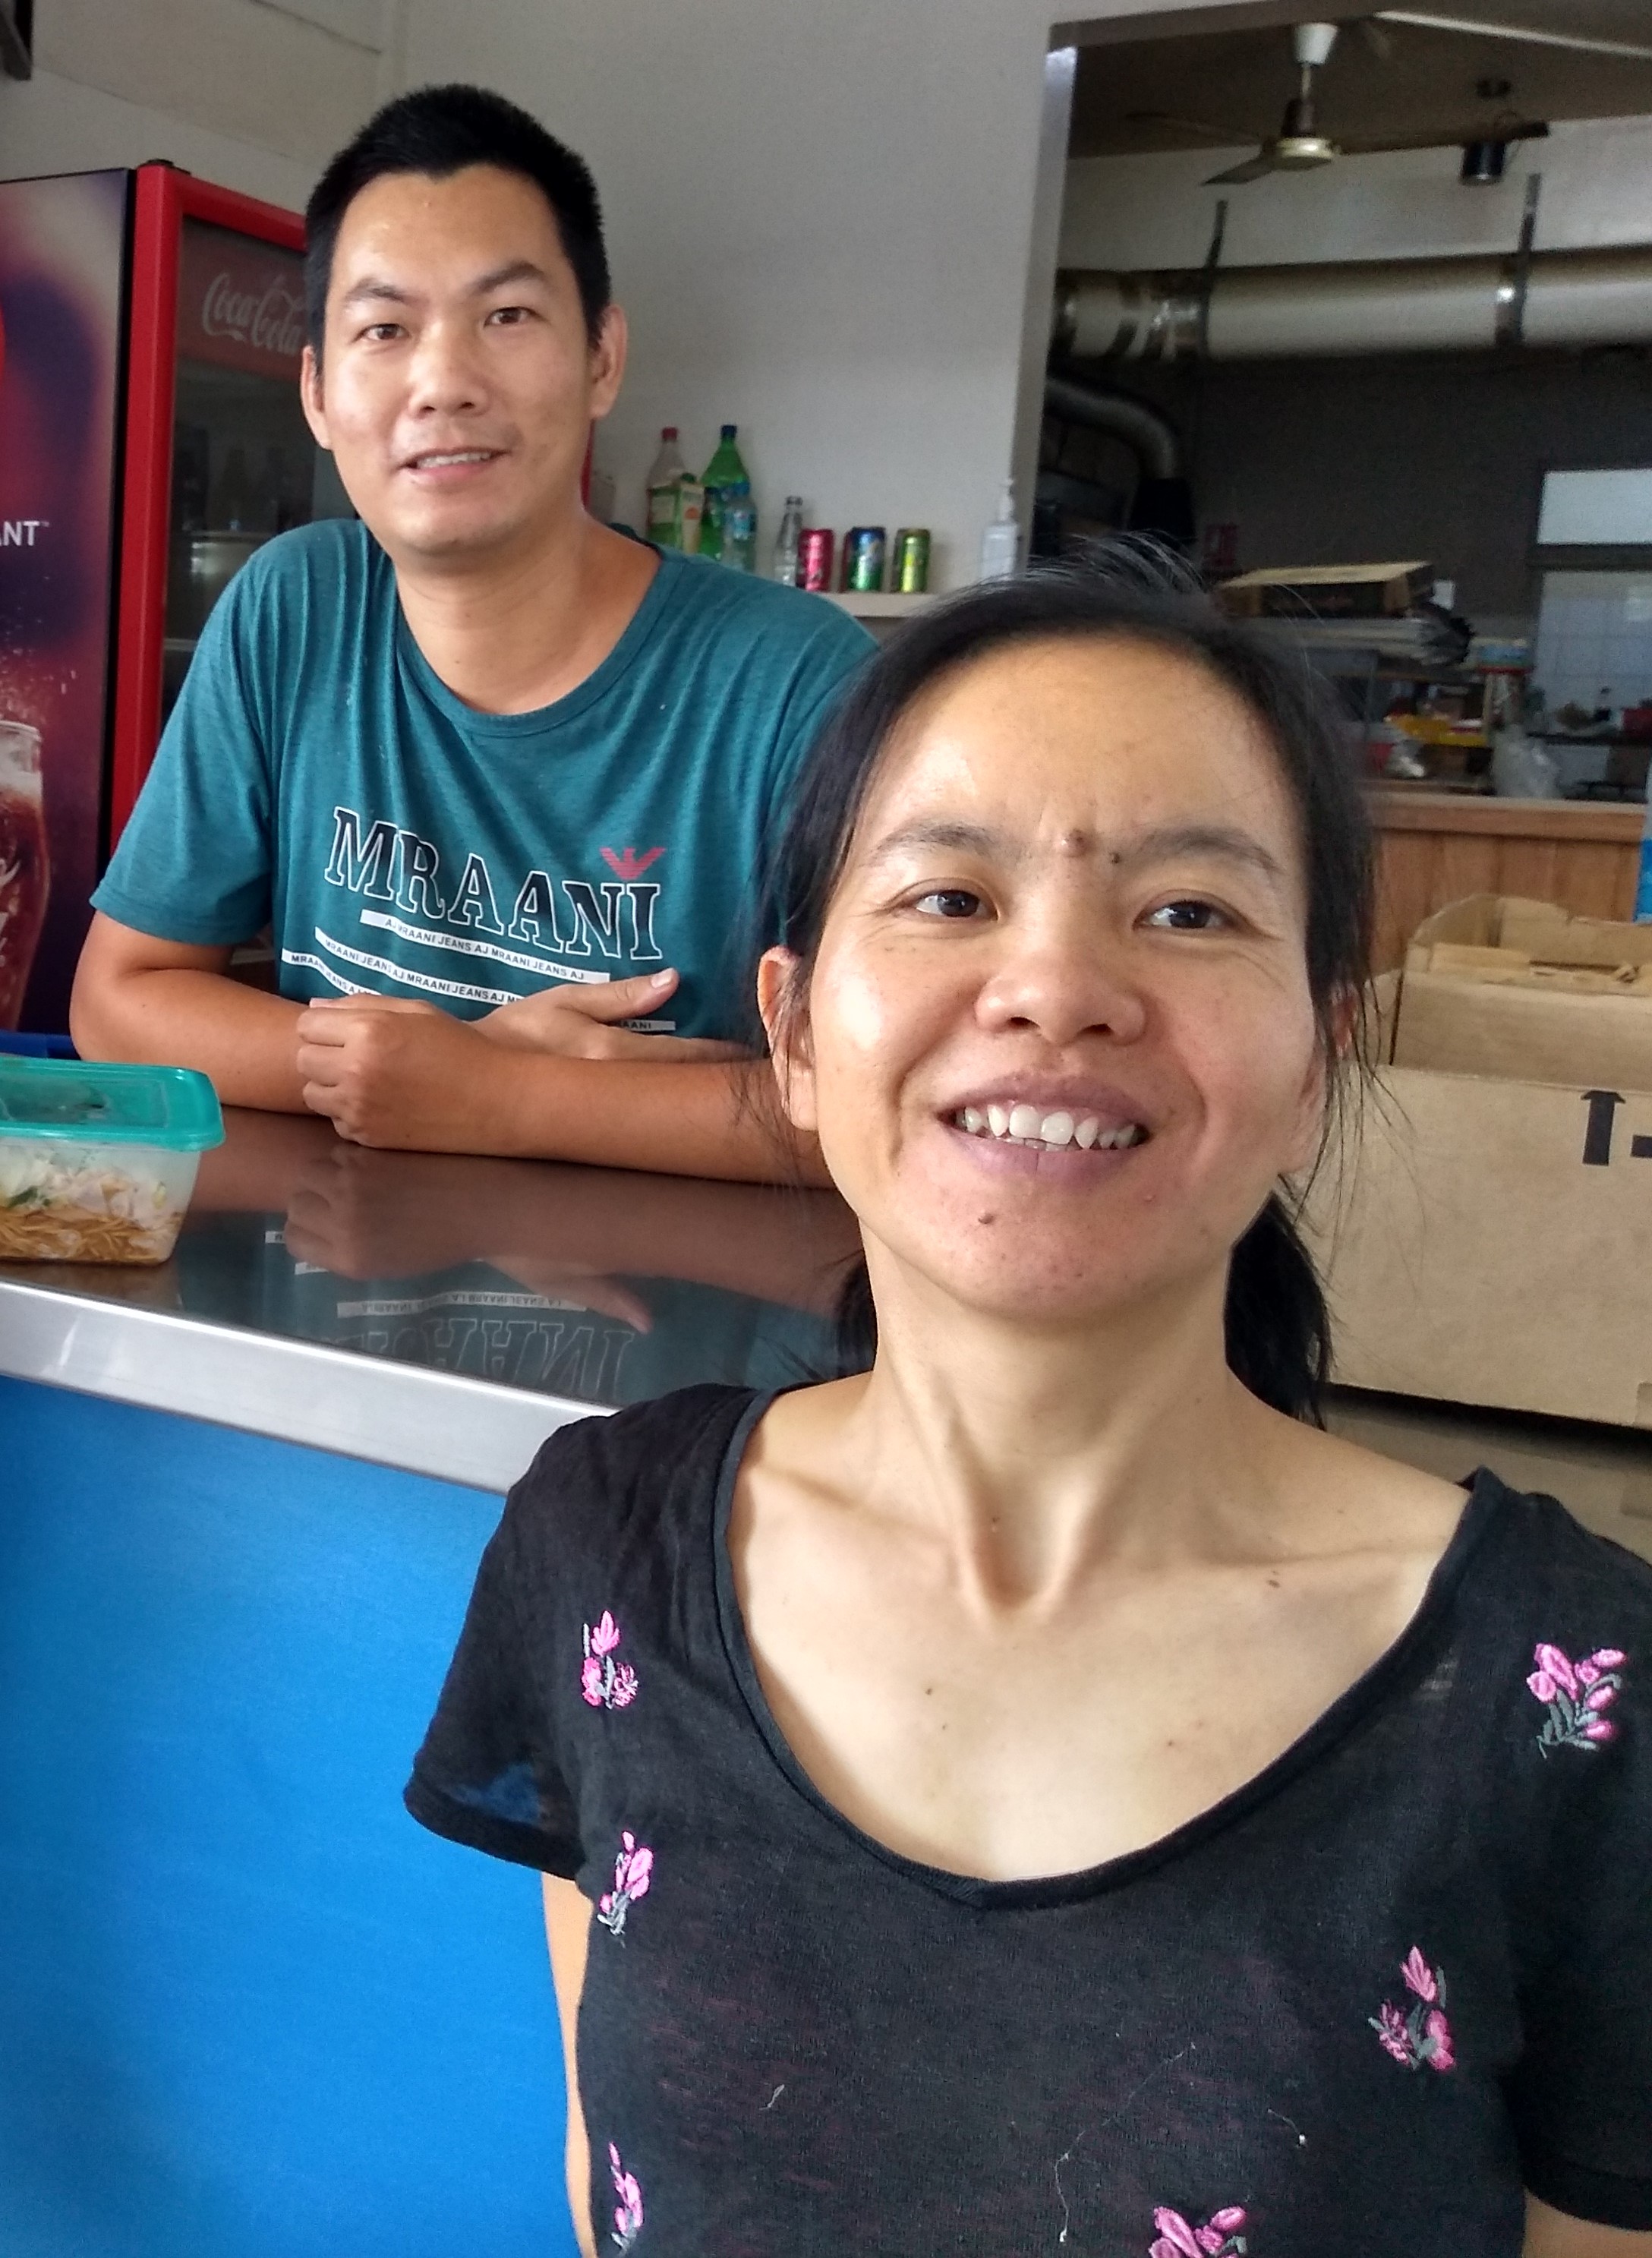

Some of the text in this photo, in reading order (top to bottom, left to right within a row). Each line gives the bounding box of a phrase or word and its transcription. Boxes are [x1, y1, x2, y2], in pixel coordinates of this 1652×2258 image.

[324, 806, 663, 960] MRAANI
[325, 938, 360, 961] MRAANI
[361, 954, 393, 973] JEANS
[393, 969, 405, 980] AJ
[406, 974, 451, 992] MRAANI
[452, 986, 489, 999] JEANS
[490, 993, 504, 1002] AJ
[385, 919, 397, 929] AJ
[438, 936, 471, 952] JEANS
[474, 945, 489, 954] AJ
[491, 948, 530, 967] MRAANI
[533, 962, 567, 977] JEANS
[570, 971, 585, 980] AJ
